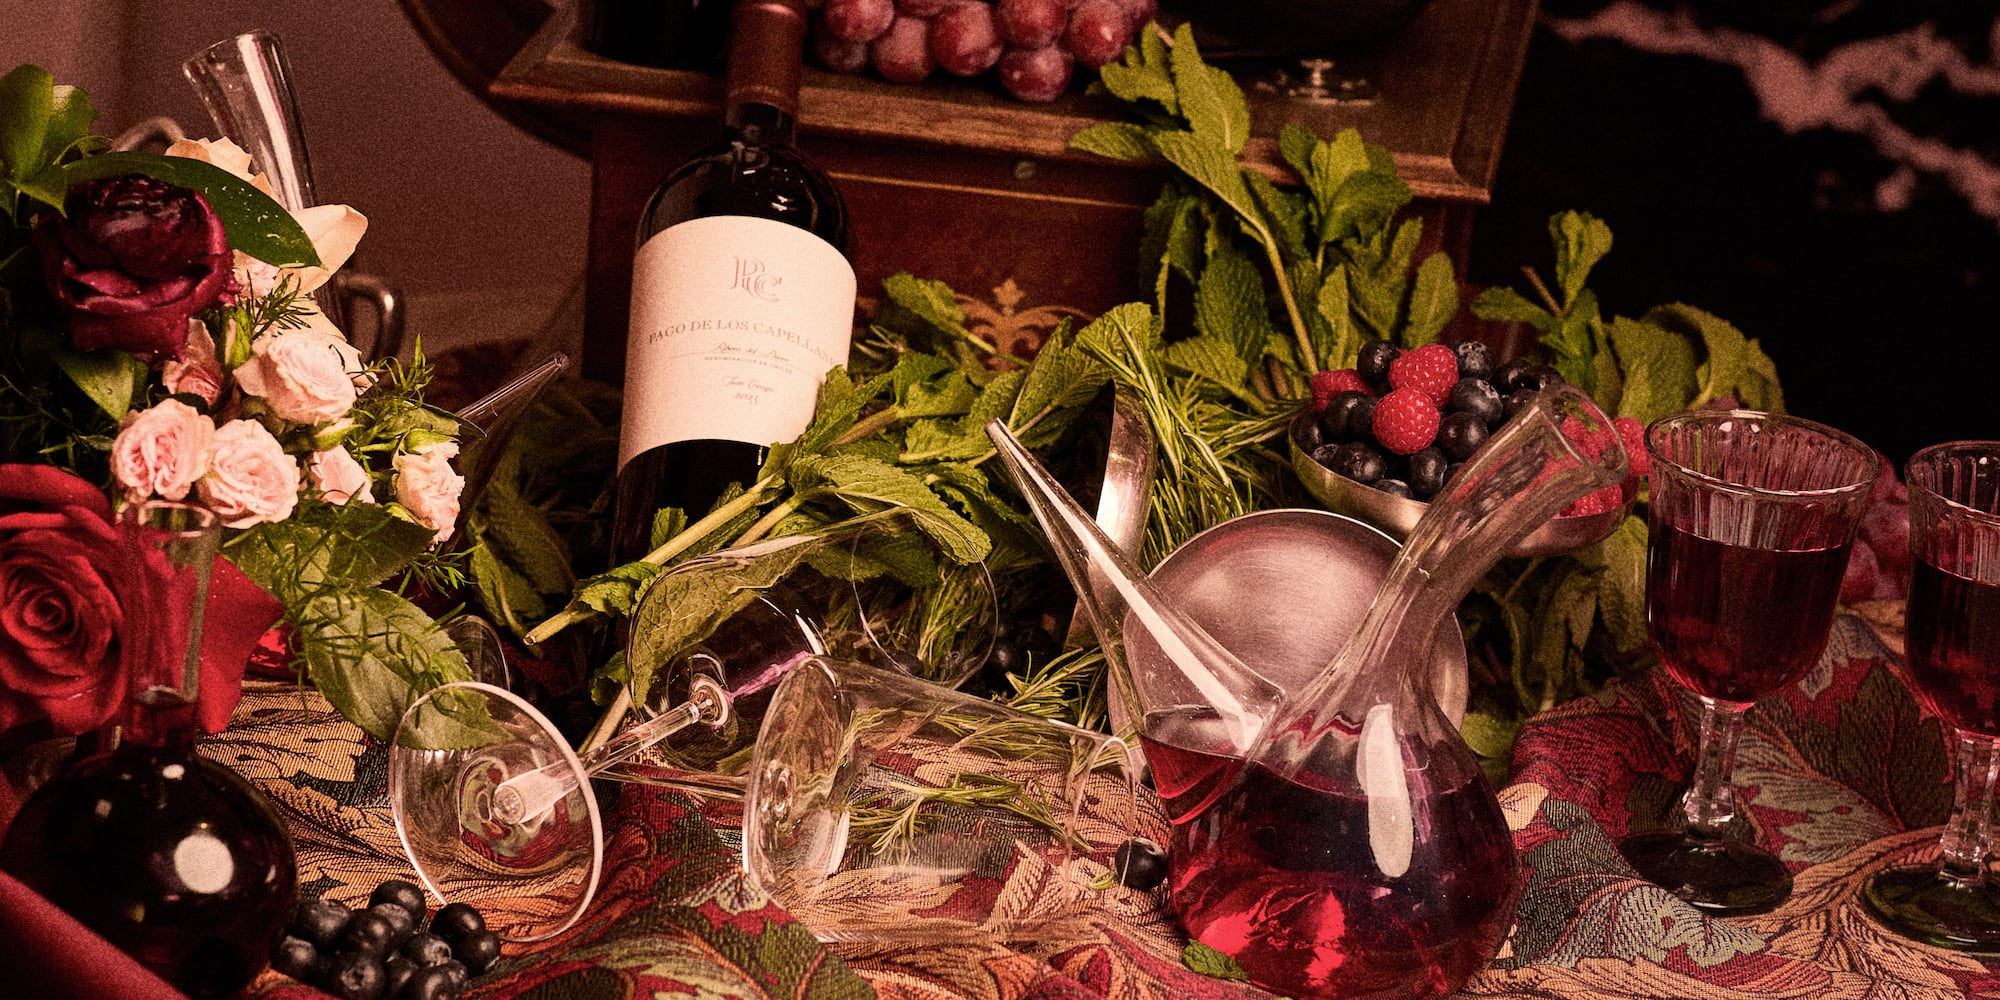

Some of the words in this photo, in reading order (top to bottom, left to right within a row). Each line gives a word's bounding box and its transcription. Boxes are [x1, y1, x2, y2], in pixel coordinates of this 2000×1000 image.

[649, 324, 686, 344] PAGO
[690, 320, 712, 332] DE
[717, 319, 749, 330] LOS
[753, 322, 837, 366] CAPELLAN
